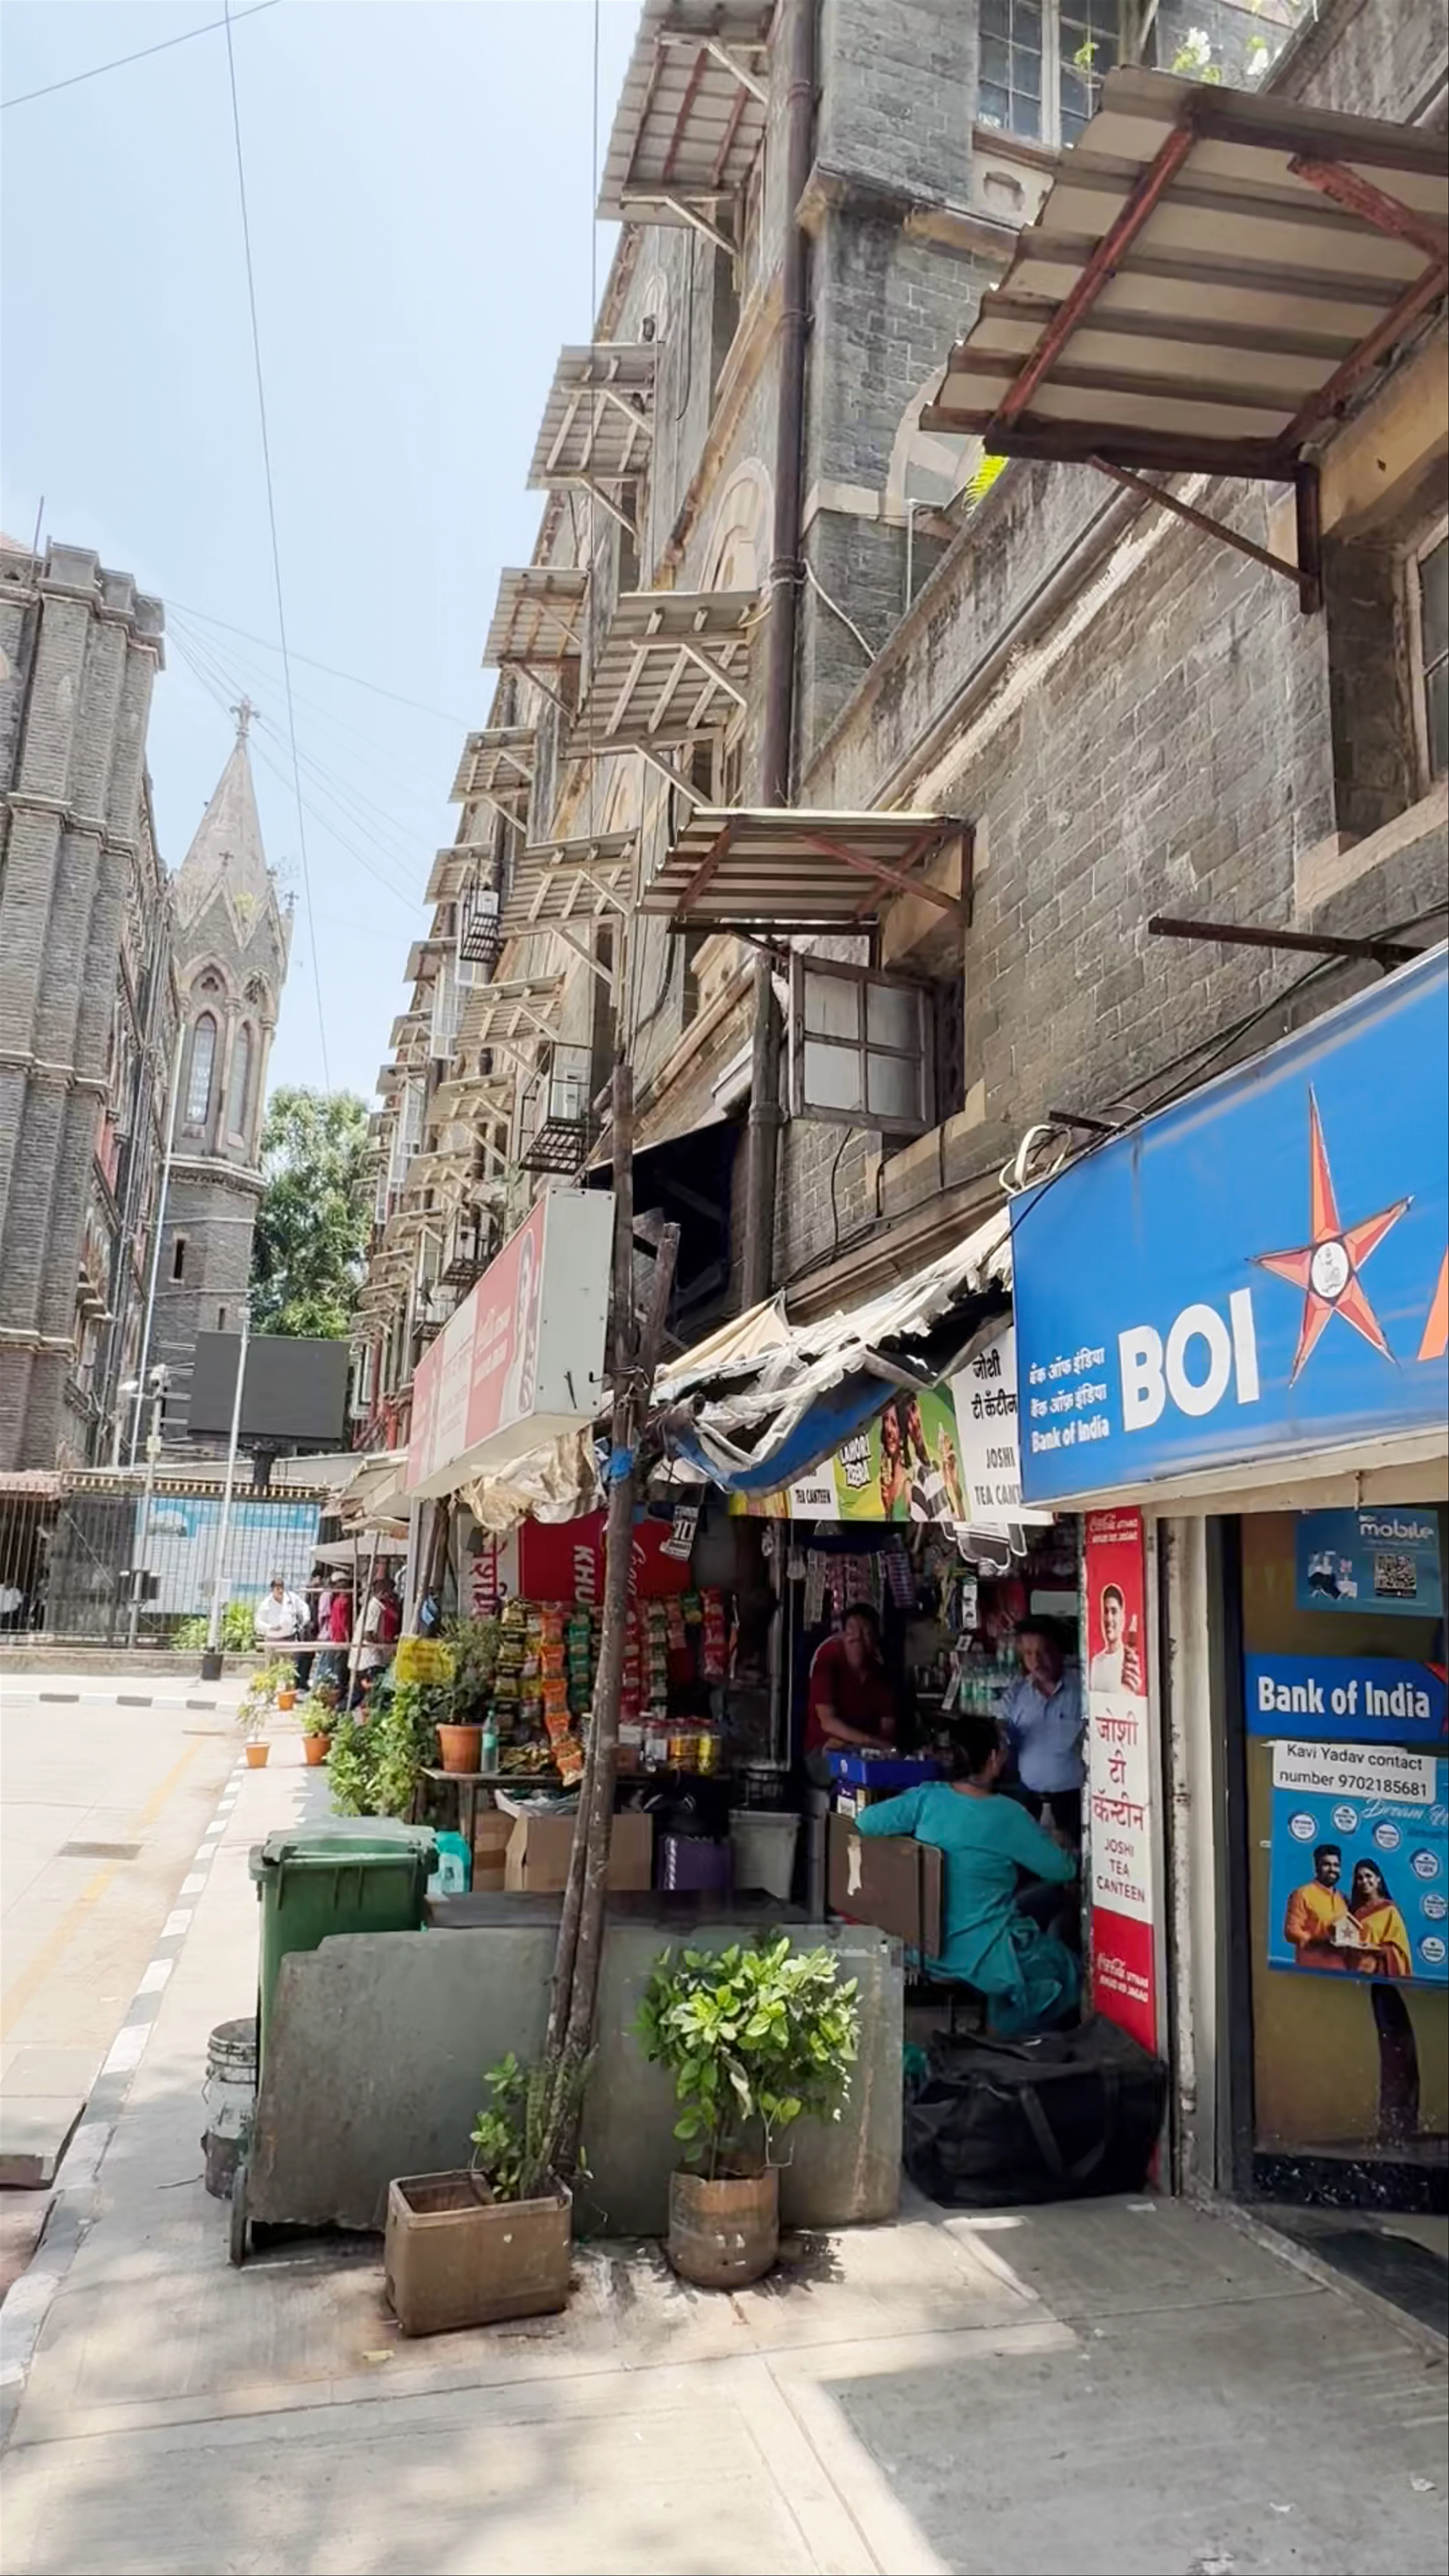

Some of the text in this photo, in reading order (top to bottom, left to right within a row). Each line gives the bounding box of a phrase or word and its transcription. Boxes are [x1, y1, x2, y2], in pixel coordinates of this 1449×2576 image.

[1074, 1347, 1105, 1374] इंडिया
[1118, 1287, 1259, 1432] BOI
[971, 1393, 983, 1419] टी
[1075, 1383, 1107, 1410] इंडिया
[1031, 1415, 1109, 1453] Bank of India
[987, 1447, 1016, 1469] JOSHI
[974, 1485, 994, 1505] TEA
[1360, 1518, 1434, 1539] mobile
[574, 1545, 595, 1604] KHU
[1258, 1675, 1430, 1718] Bank of India
[1095, 1708, 1138, 1747] जोशी
[1108, 1750, 1126, 1785] टी
[1287, 1744, 1422, 1770] Kavi Yadav contact
[1280, 1771, 1426, 1796] number 9702185681
[1105, 1838, 1134, 1858] JOSHI
[1110, 1859, 1130, 1878] TEA
[1096, 1875, 1145, 1904] CANTEEN
